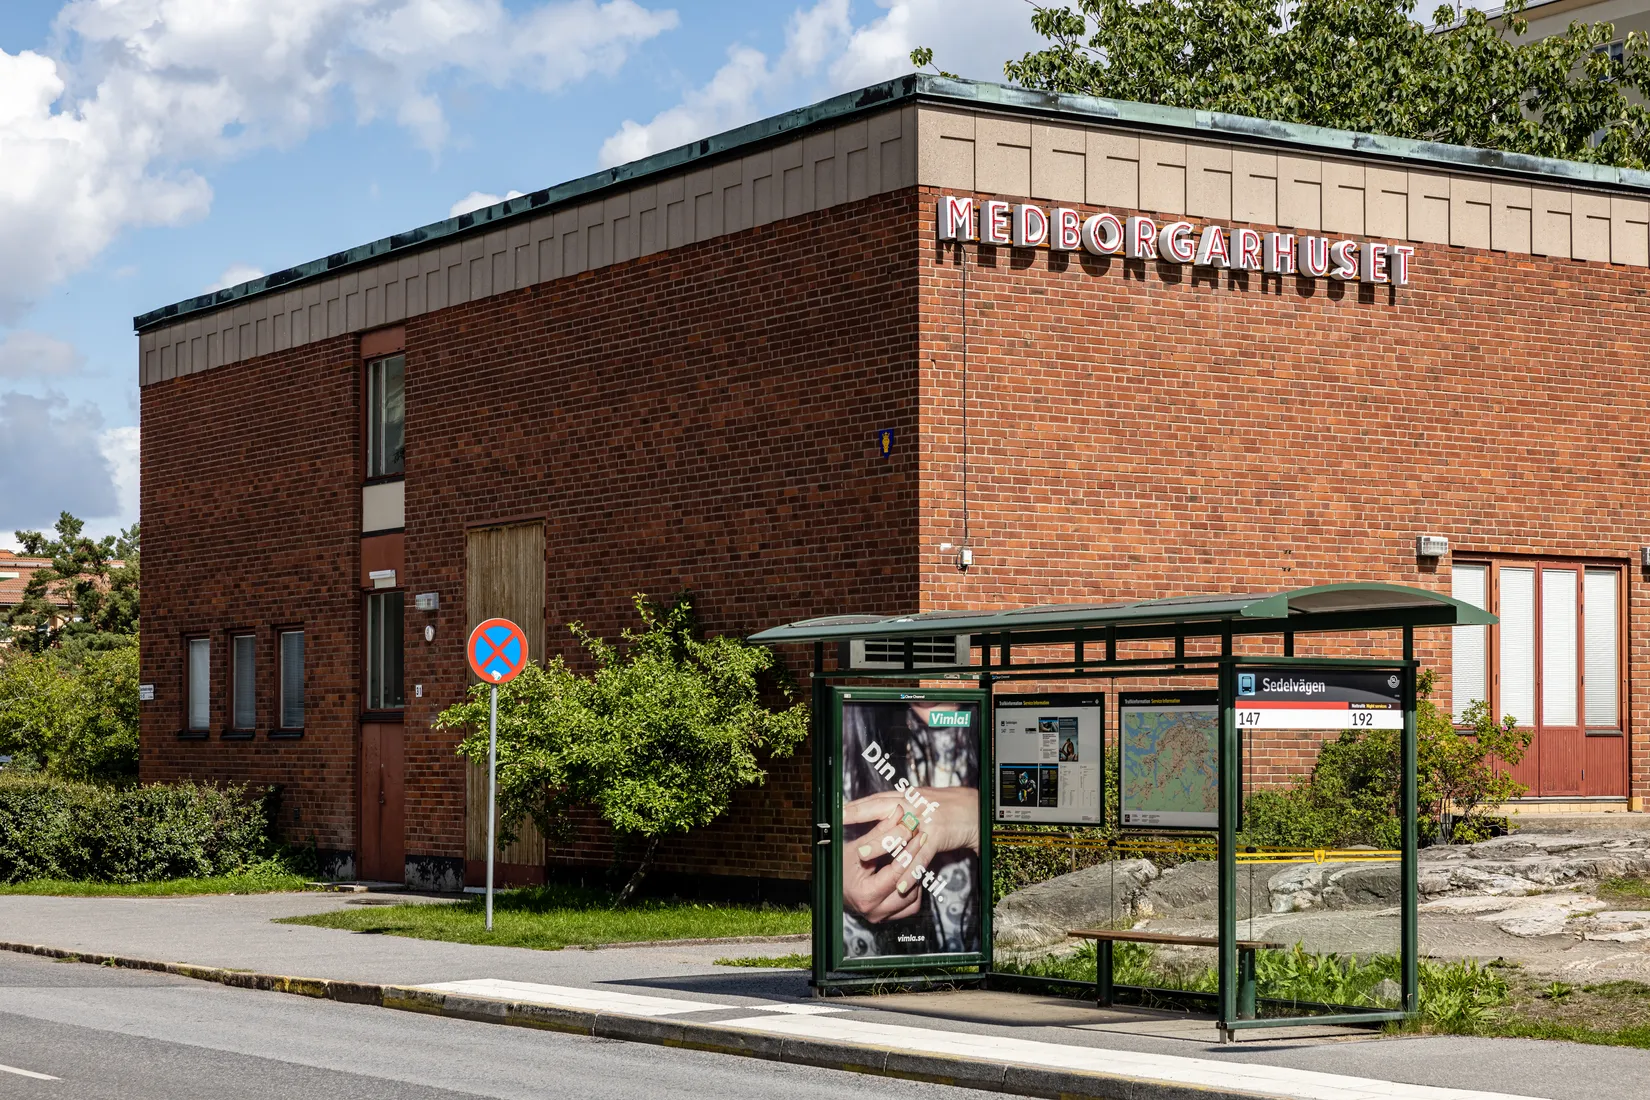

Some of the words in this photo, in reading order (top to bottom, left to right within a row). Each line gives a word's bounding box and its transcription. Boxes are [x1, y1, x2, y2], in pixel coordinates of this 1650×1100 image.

[937, 195, 1415, 286] MEDBORGARHUSET
[1262, 677, 1326, 695] Sedelvägen
[931, 711, 969, 726] Vimla!
[1238, 712, 1261, 726] 147
[1351, 712, 1373, 726] 192
[861, 740, 897, 782] Din
[894, 777, 940, 824] surf,
[881, 835, 913, 868] din
[911, 864, 948, 903] stil.
[897, 933, 926, 943] vimla.se
